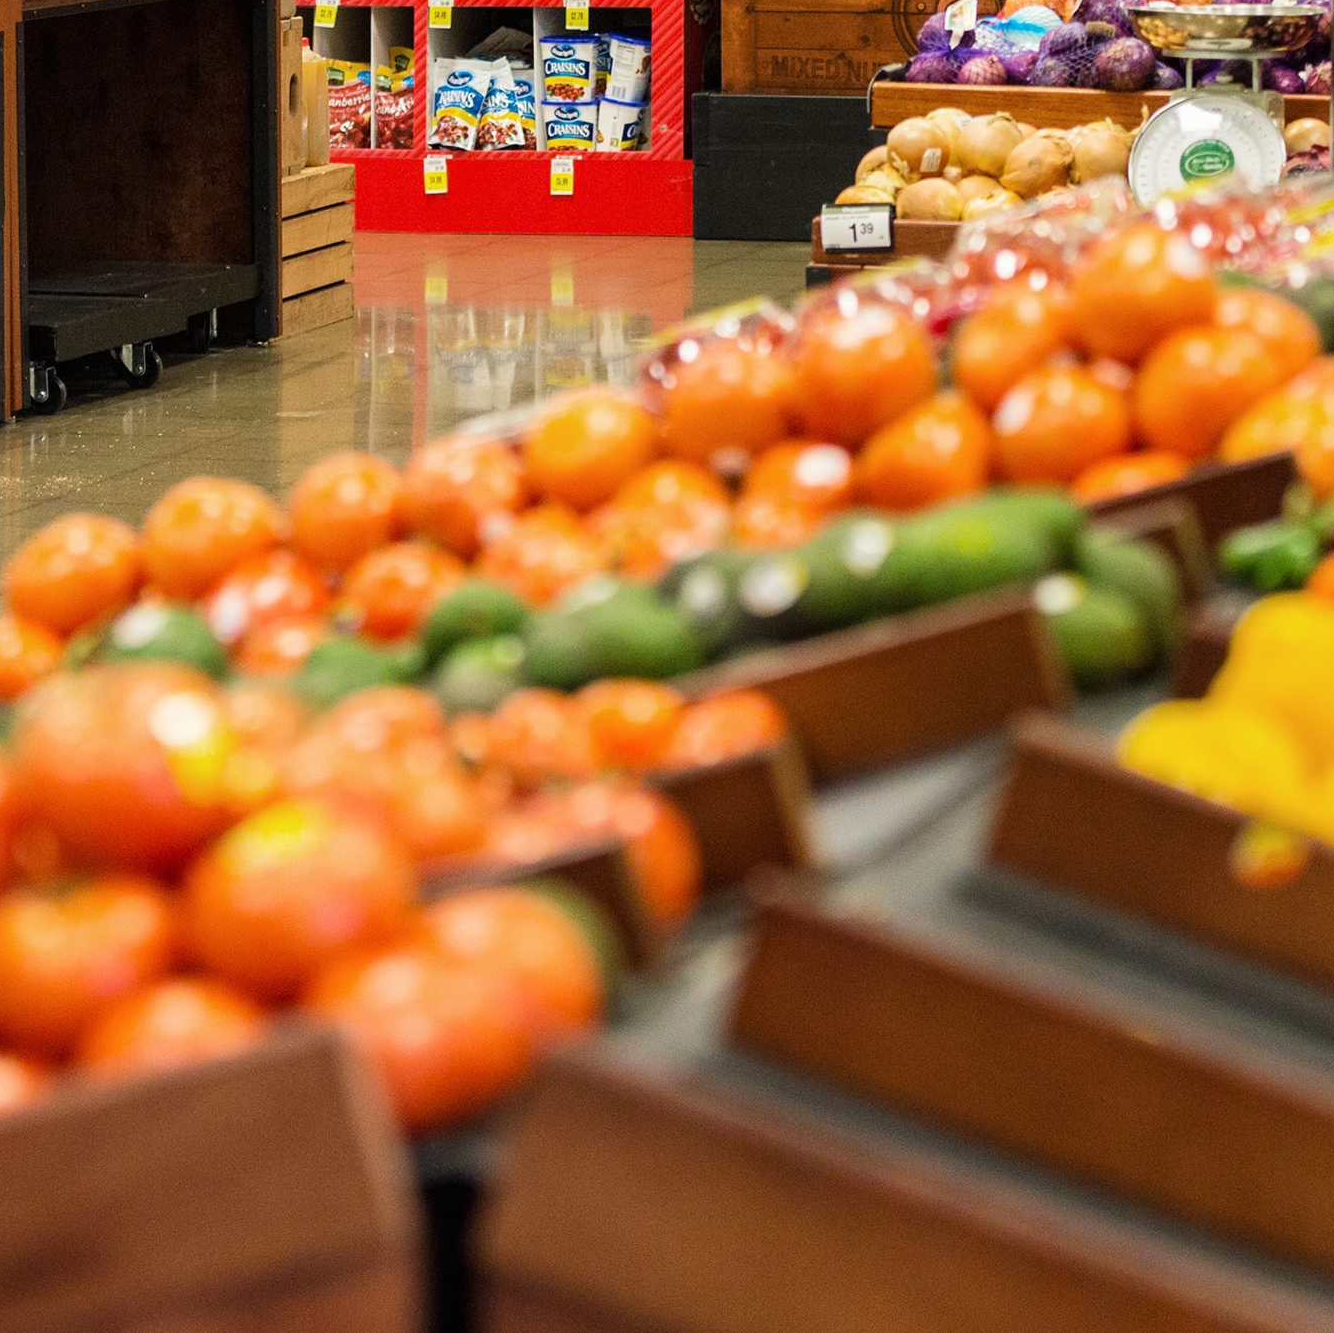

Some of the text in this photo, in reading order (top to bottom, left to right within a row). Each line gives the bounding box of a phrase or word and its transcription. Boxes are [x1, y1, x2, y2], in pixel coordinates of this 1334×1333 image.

[544, 61, 586, 76] CRAISINS
[771, 55, 843, 81] MIXED
[329, 93, 371, 107] anberrie
[547, 123, 591, 138] CRAISINS
